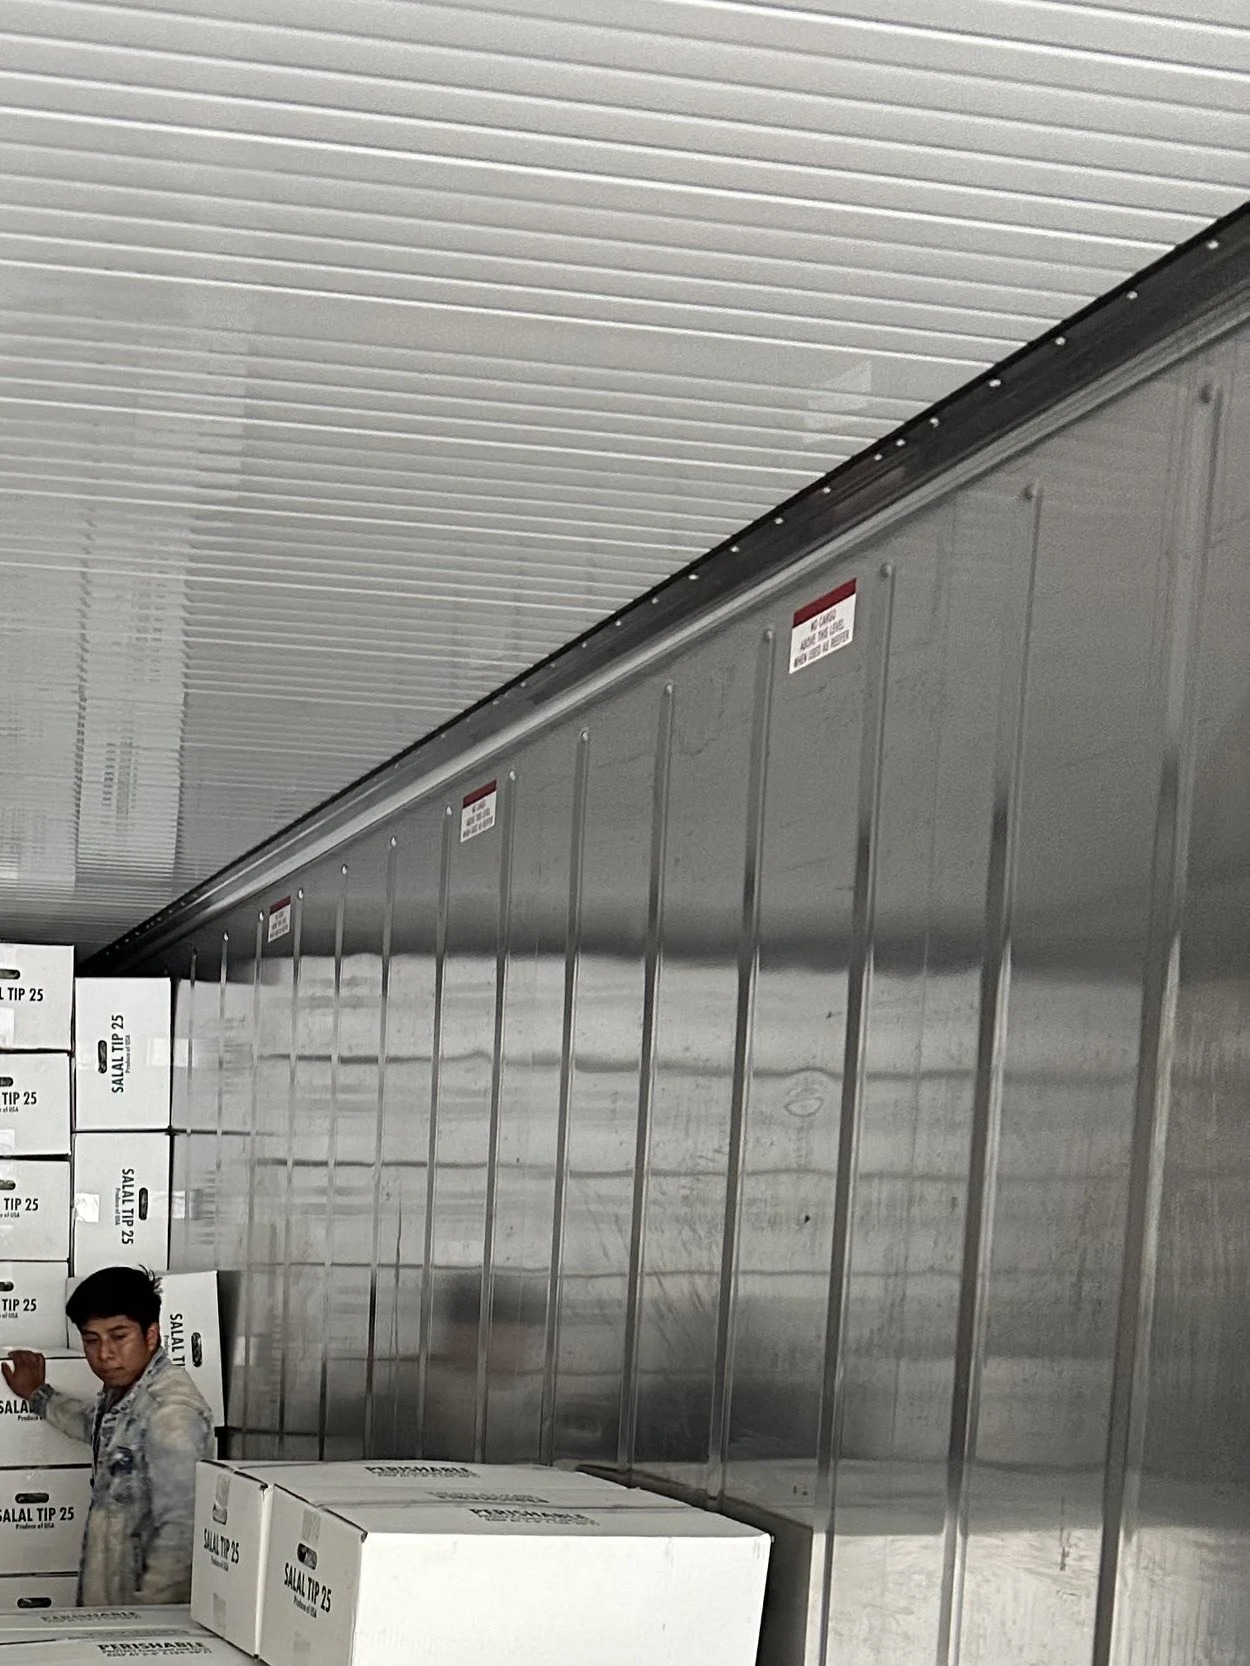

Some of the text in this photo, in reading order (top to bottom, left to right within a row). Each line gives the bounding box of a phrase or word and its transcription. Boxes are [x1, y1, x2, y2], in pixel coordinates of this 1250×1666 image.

[7, 987, 26, 1001] TIP
[29, 988, 44, 1002] 25
[111, 1014, 124, 1094] SALAL TIP 25
[1, 1091, 20, 1106] TIP
[23, 1091, 37, 1105] 25
[3, 1197, 22, 1211] TIP
[25, 1198, 39, 1212] 25
[121, 1168, 135, 1245] SALAL TIP 25
[1, 1298, 20, 1312] TIP
[22, 1298, 37, 1312] 25
[169, 1313, 185, 1353] SALAL
[36, 1507, 56, 1522] TIP
[59, 1506, 75, 1521] 25
[203, 1527, 220, 1556] SALAL
[220, 1536, 231, 1559] TIP
[230, 1539, 240, 1564] 25
[283, 1562, 306, 1598] SALAL
[306, 1576, 320, 1606] TIP
[320, 1585, 332, 1613] 25
[97, 1641, 206, 1651] PERISHABLE
